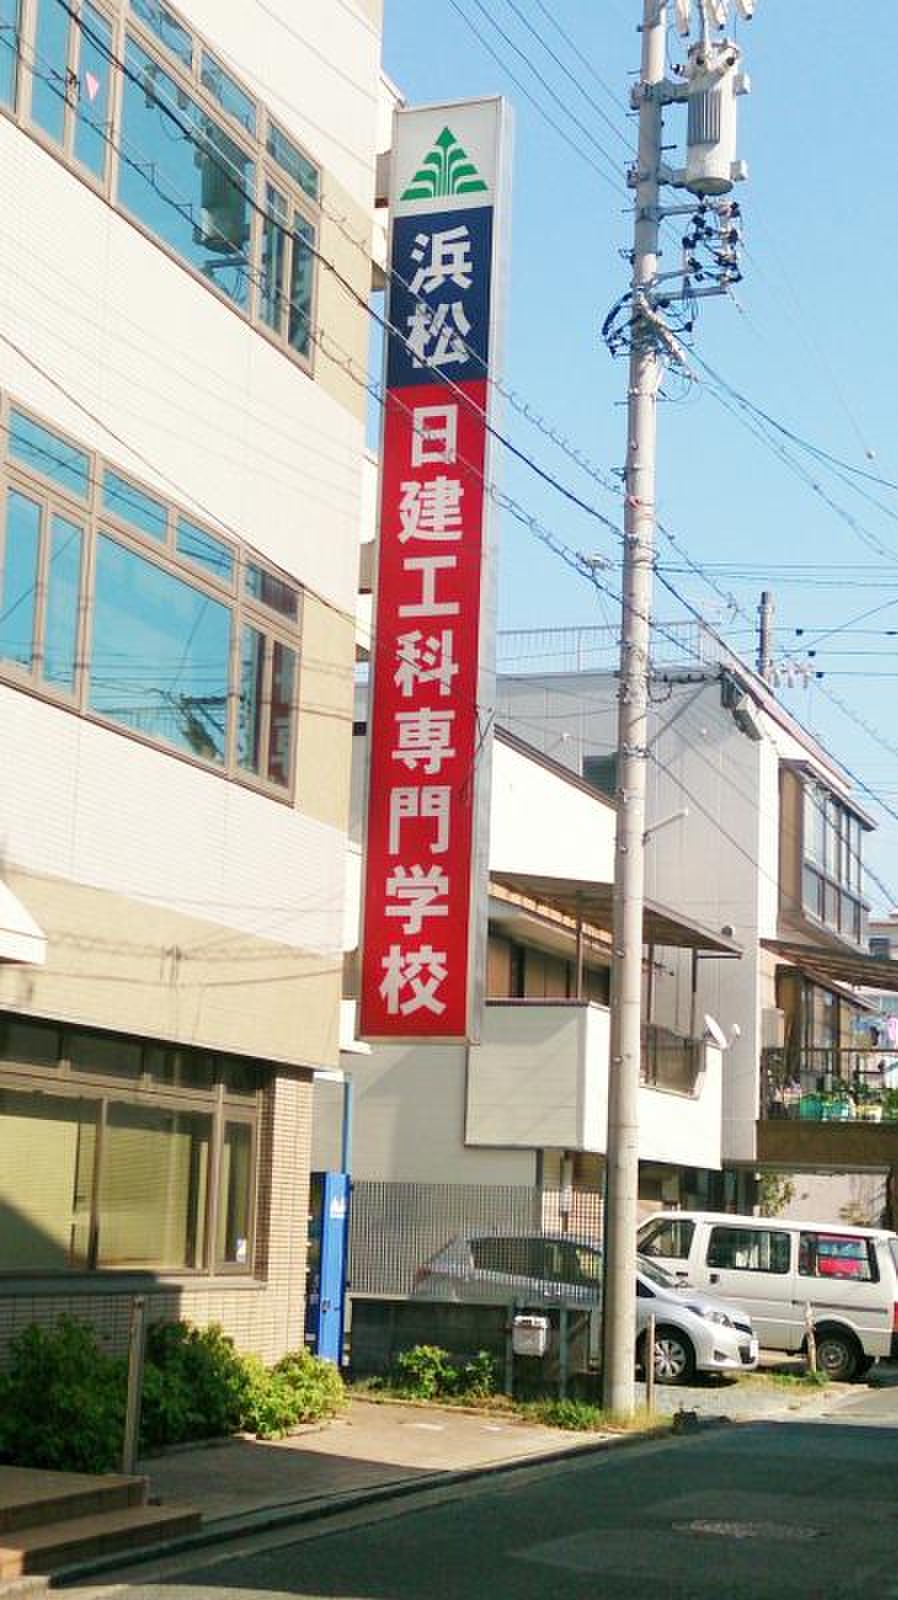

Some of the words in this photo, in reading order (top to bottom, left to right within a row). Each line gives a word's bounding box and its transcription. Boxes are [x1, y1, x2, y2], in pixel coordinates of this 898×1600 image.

[406, 225, 473, 368] 浜松
[379, 404, 464, 1015] 日建工科専門学校
